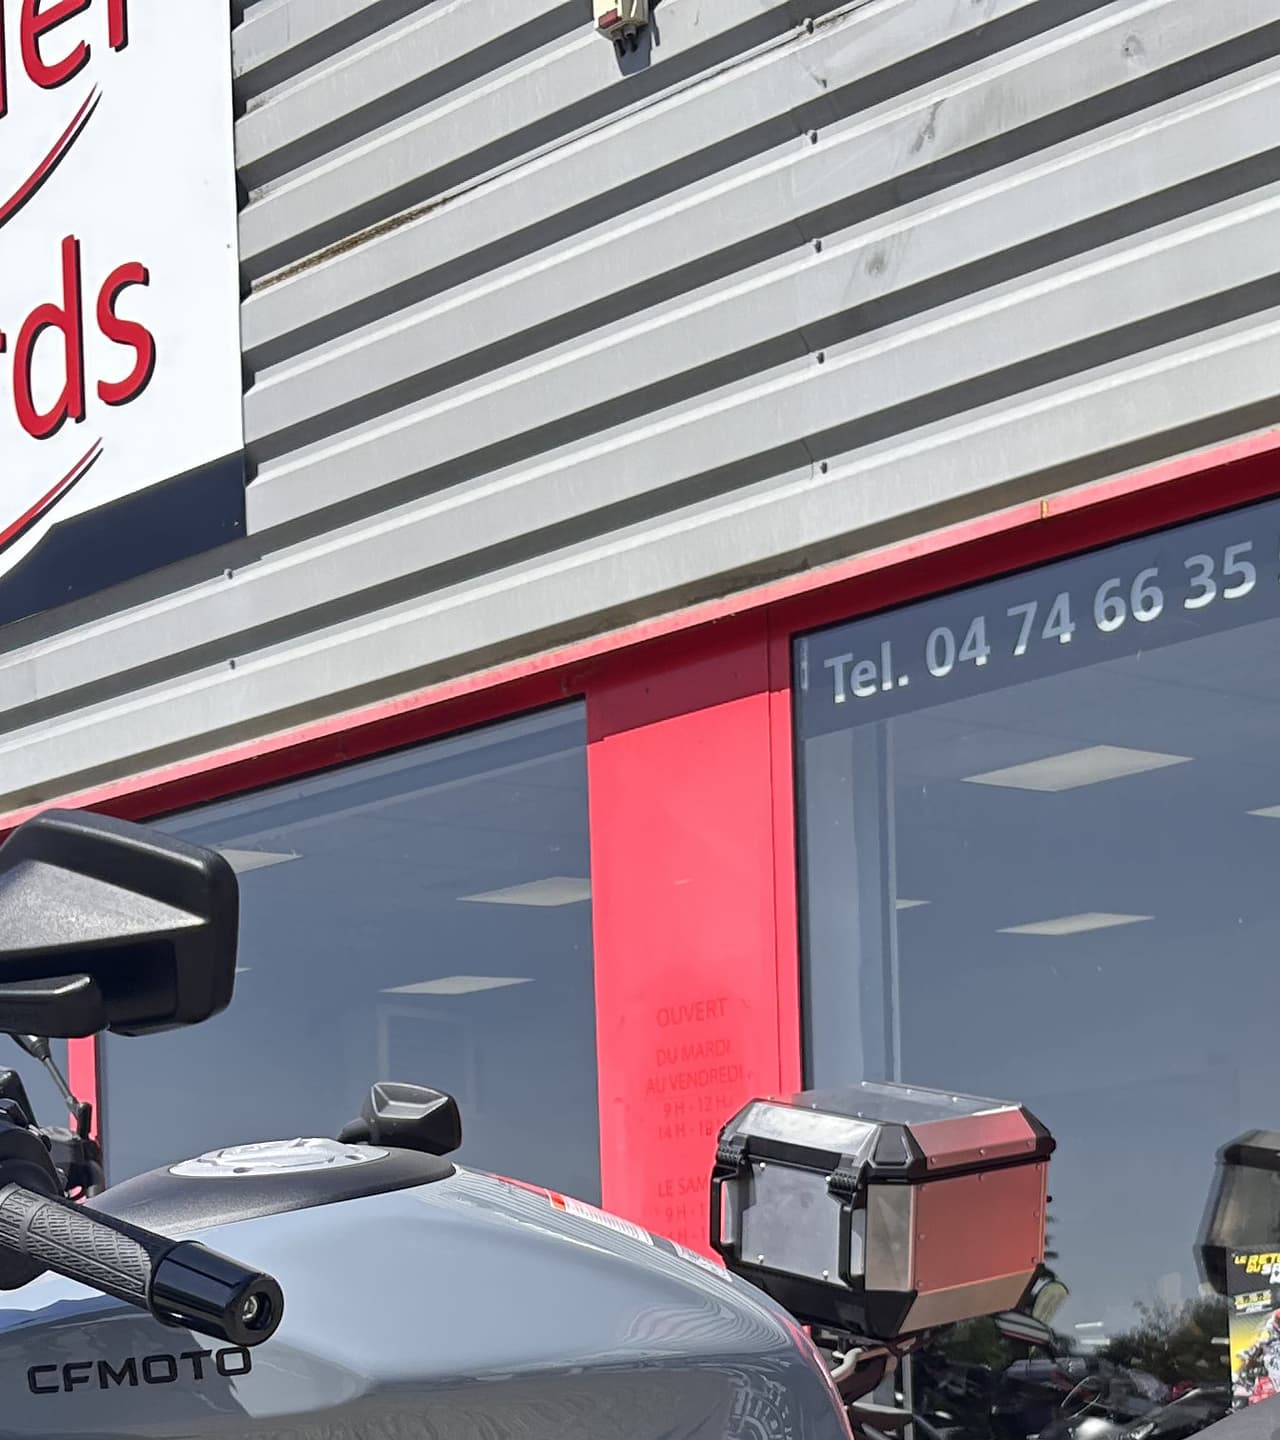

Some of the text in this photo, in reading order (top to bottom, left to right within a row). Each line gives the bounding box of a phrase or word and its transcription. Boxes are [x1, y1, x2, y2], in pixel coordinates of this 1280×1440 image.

[823, 640, 910, 703] Tel.
[925, 616, 990, 677] 04
[1006, 592, 1076, 656] 74
[1094, 567, 1164, 632] 66
[1183, 541, 1257, 609] 35
[656, 998, 728, 1028] OUVERT
[656, 1039, 731, 1066] DU MARDI
[646, 1064, 744, 1095] AU VENDREDI
[26, 1346, 252, 1395] CFMOTO
